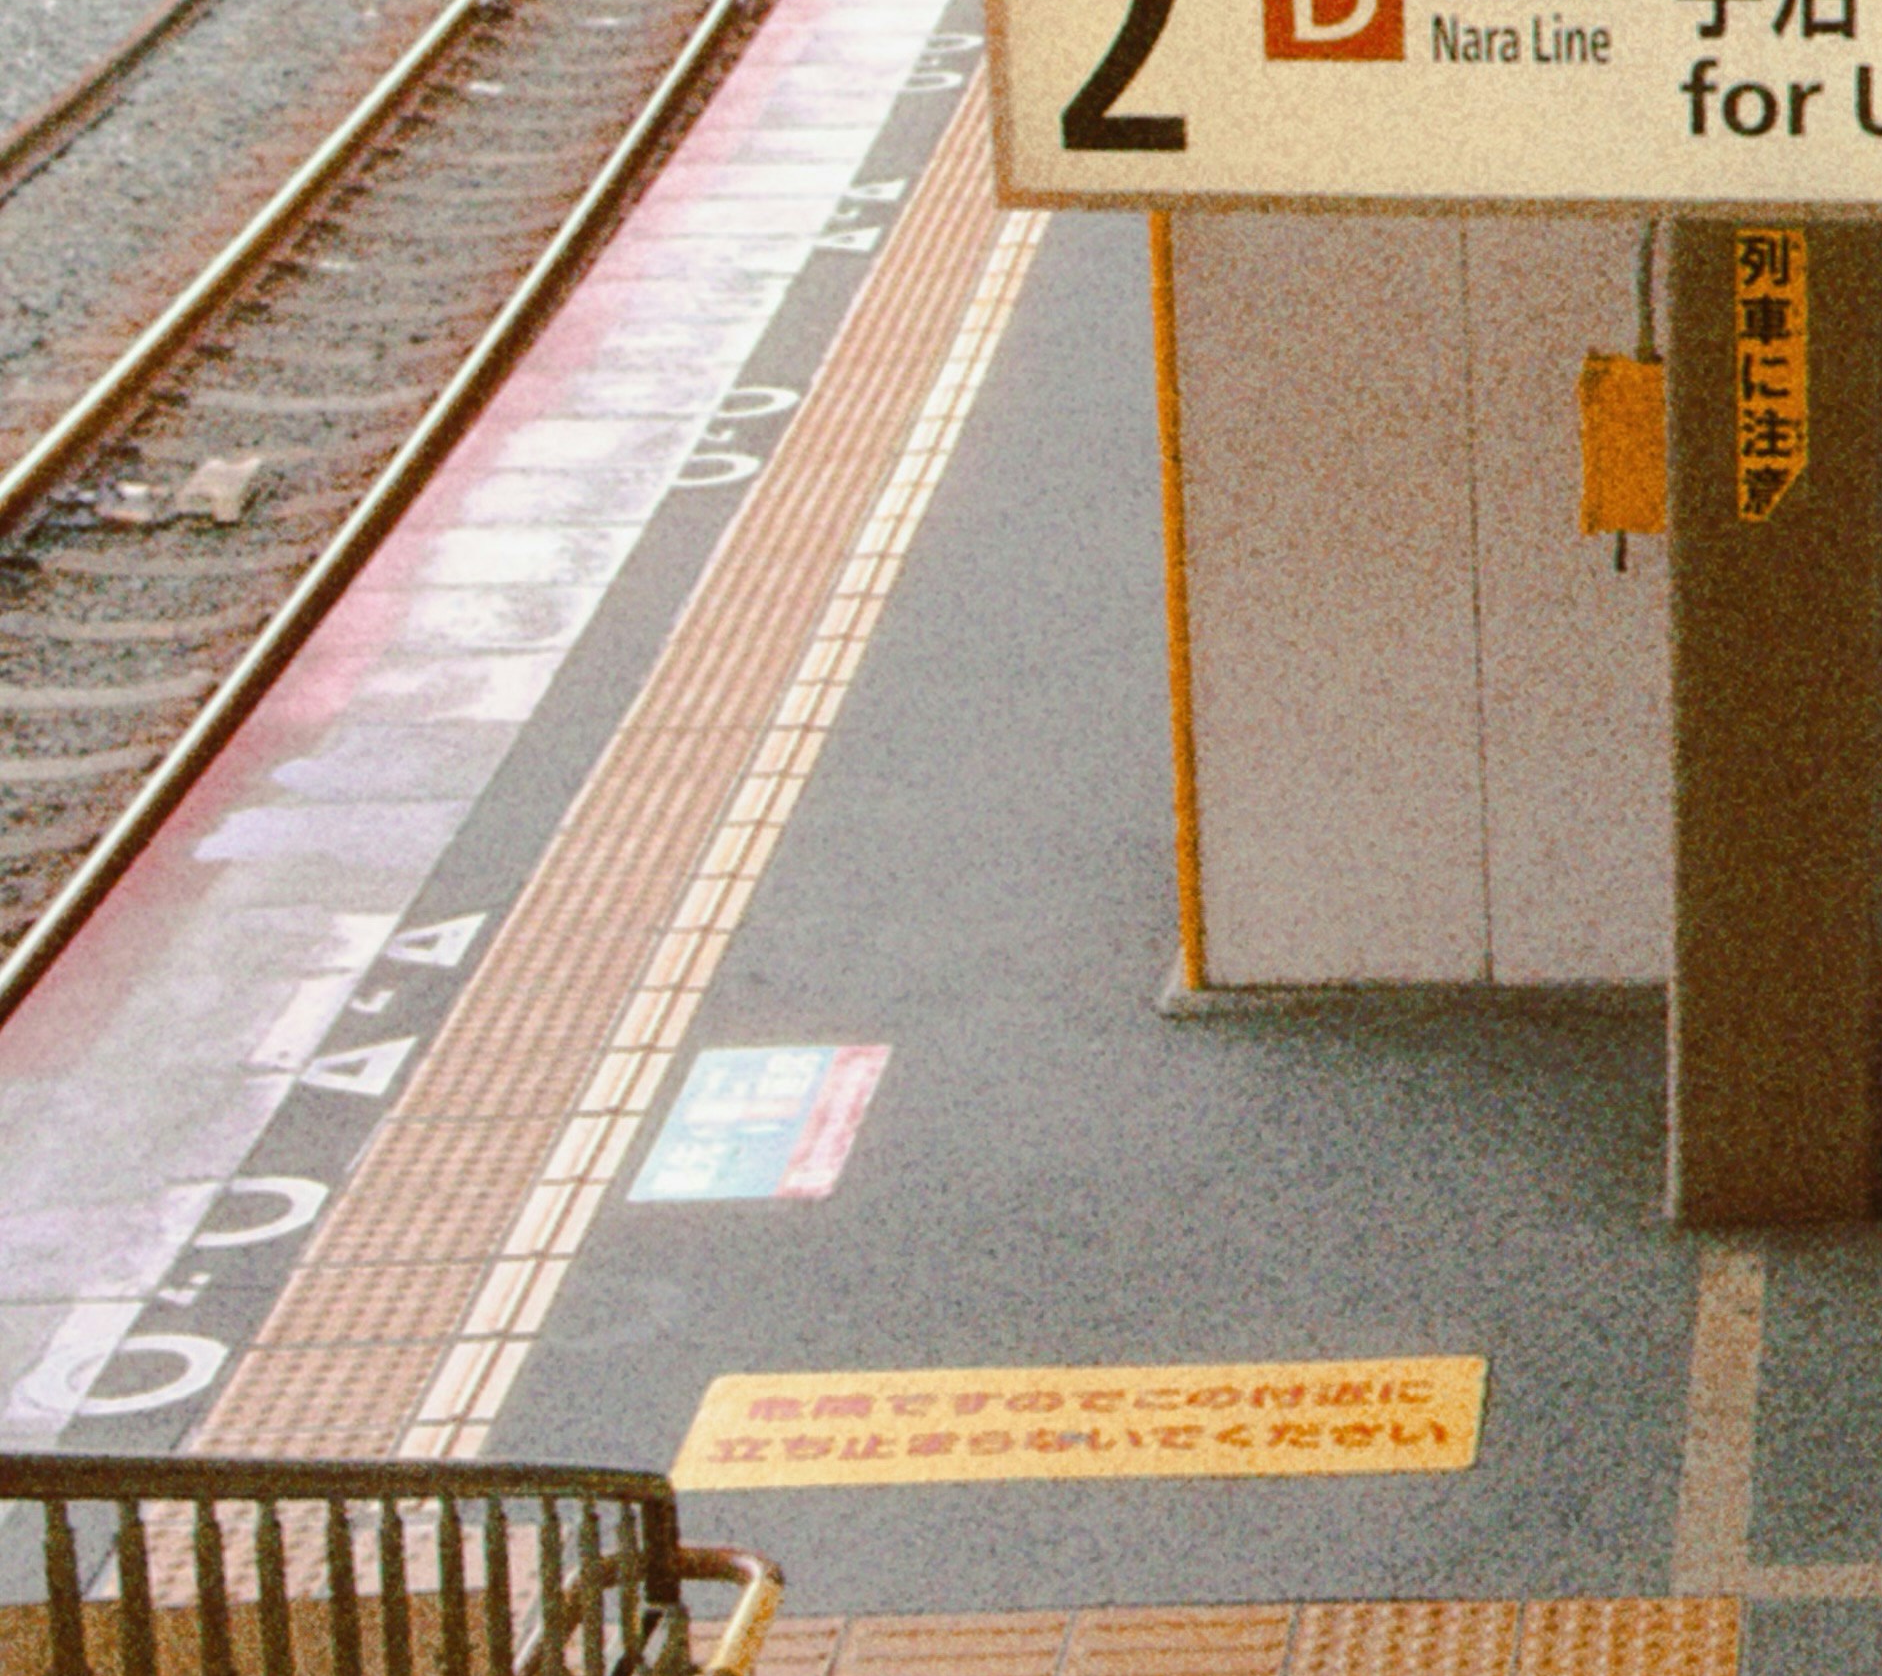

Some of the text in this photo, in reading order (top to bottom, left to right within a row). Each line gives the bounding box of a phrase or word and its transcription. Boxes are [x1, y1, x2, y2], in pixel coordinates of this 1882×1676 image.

[1431, 13, 1610, 63] Nara Line
[1680, 57, 1823, 138] for
